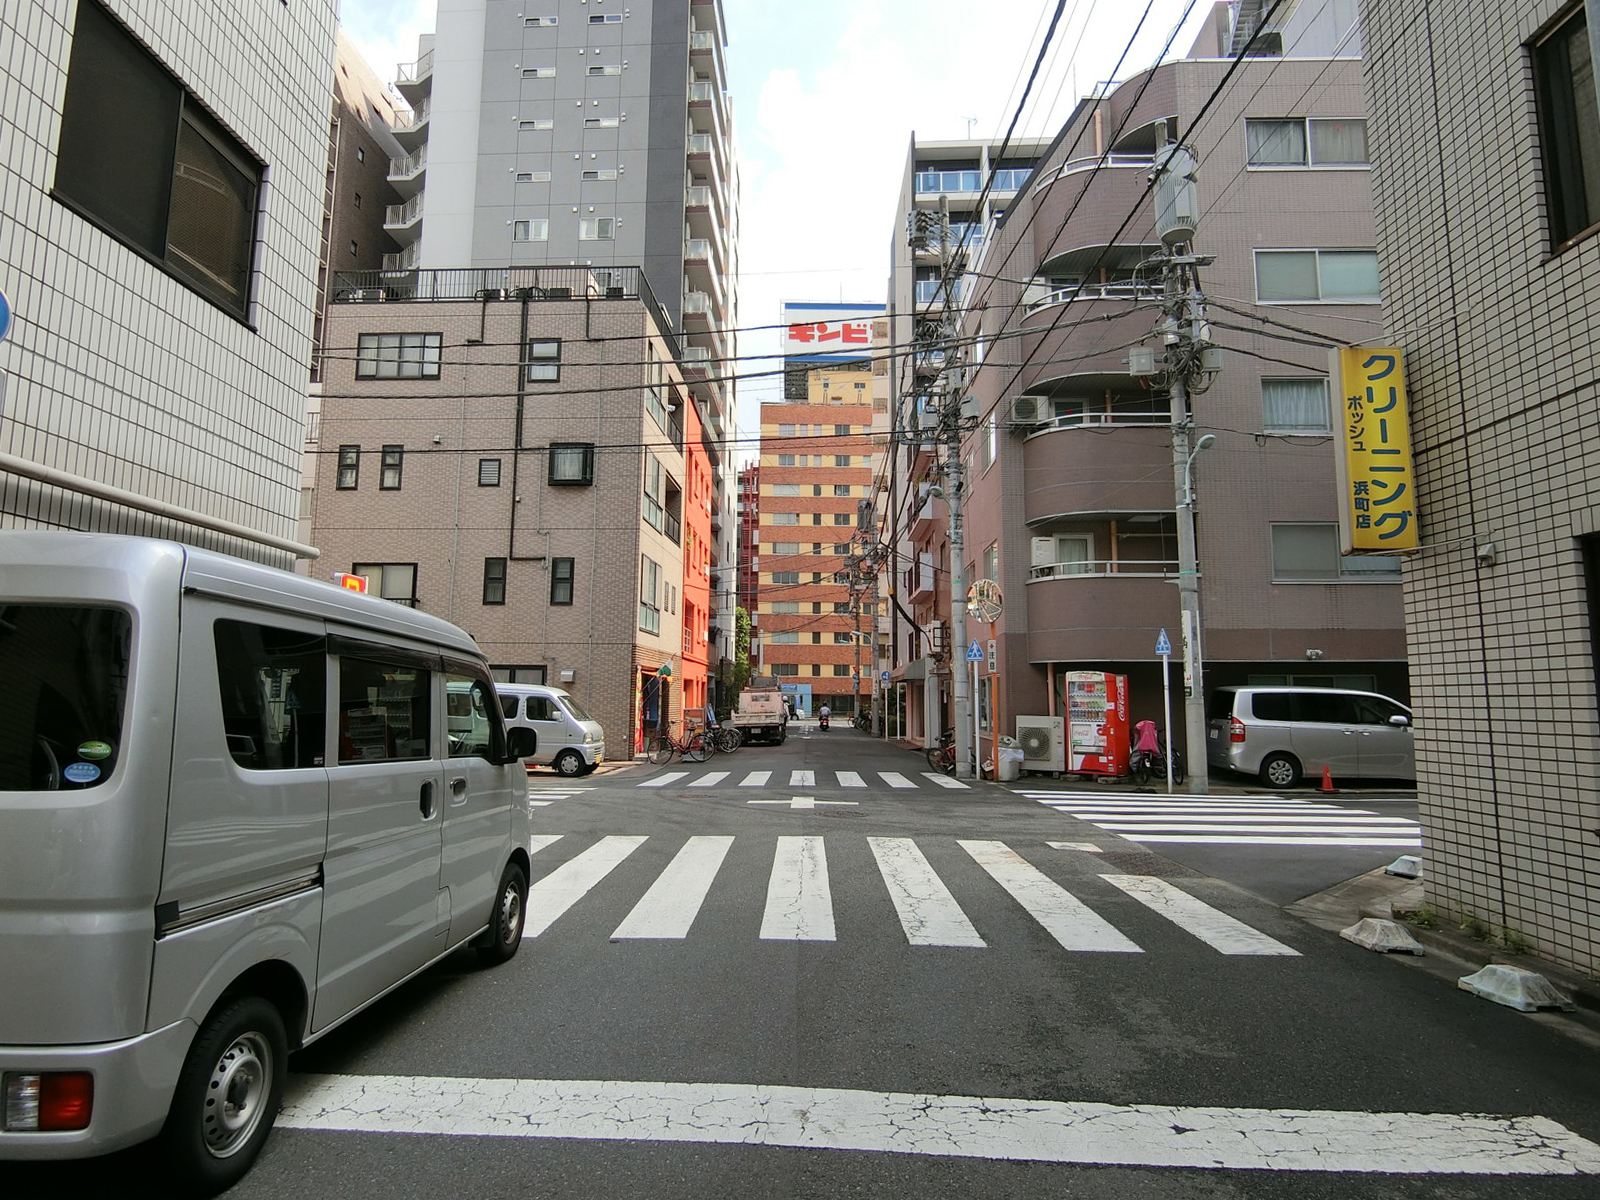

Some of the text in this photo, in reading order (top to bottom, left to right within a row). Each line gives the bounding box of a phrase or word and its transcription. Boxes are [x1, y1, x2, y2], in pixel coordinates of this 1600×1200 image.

[1347, 395, 1371, 529] ポッシュ 浜町店
[1362, 355, 1413, 540] クリーニング
